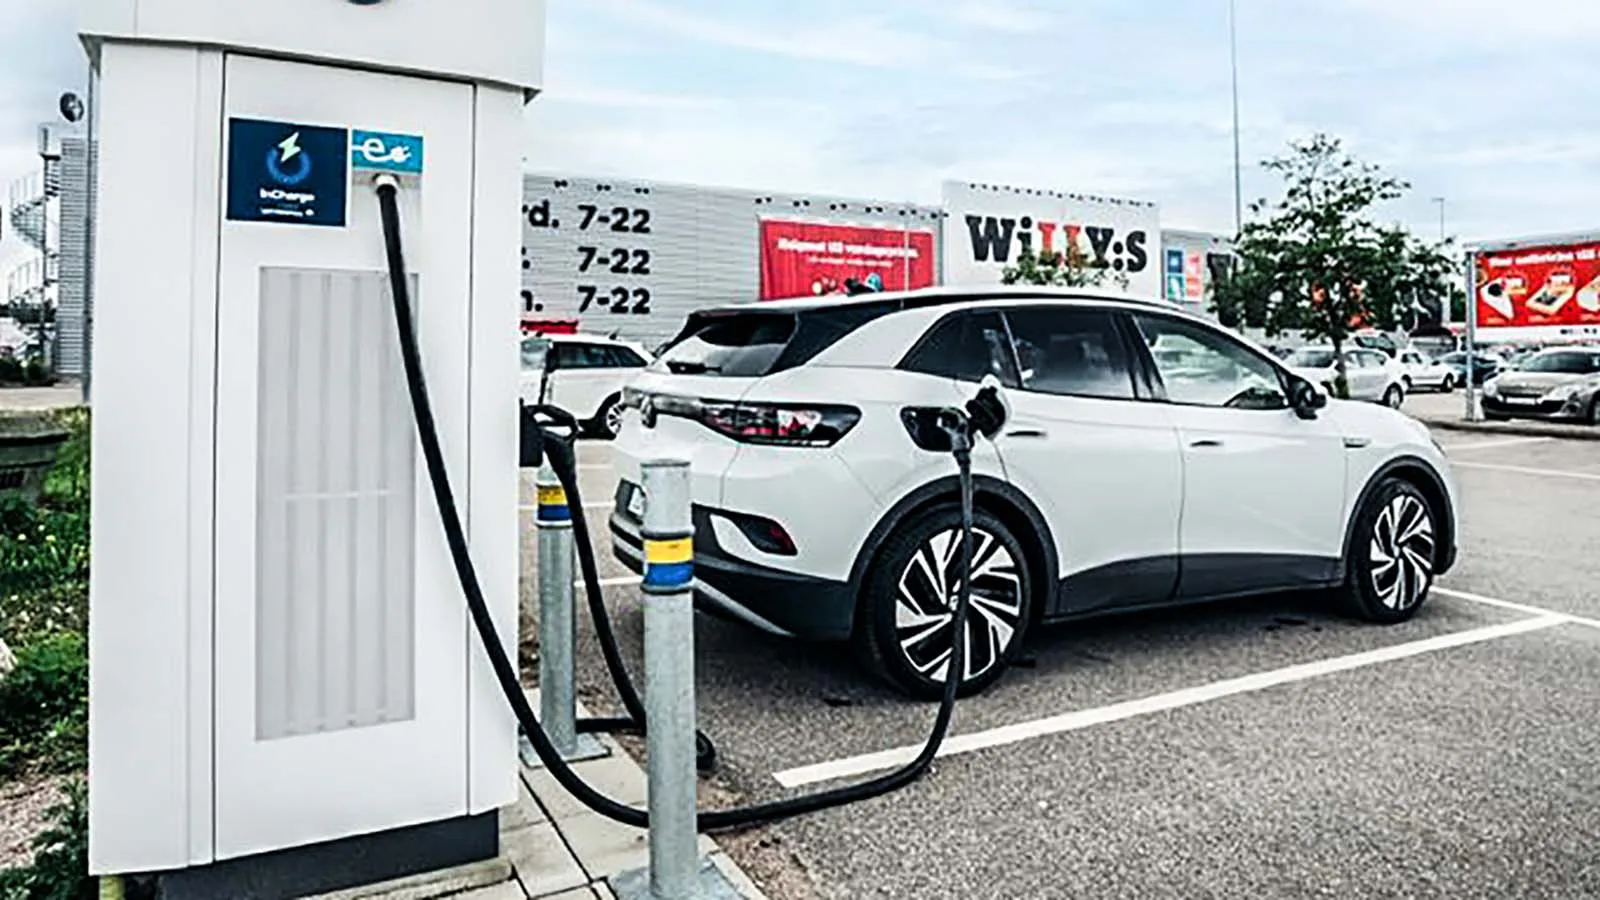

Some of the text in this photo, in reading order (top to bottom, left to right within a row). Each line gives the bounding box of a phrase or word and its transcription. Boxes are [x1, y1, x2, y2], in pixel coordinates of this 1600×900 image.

[577, 204, 651, 234] 7-22
[577, 246, 651, 275] 7-22
[577, 285, 651, 314] 7-22
